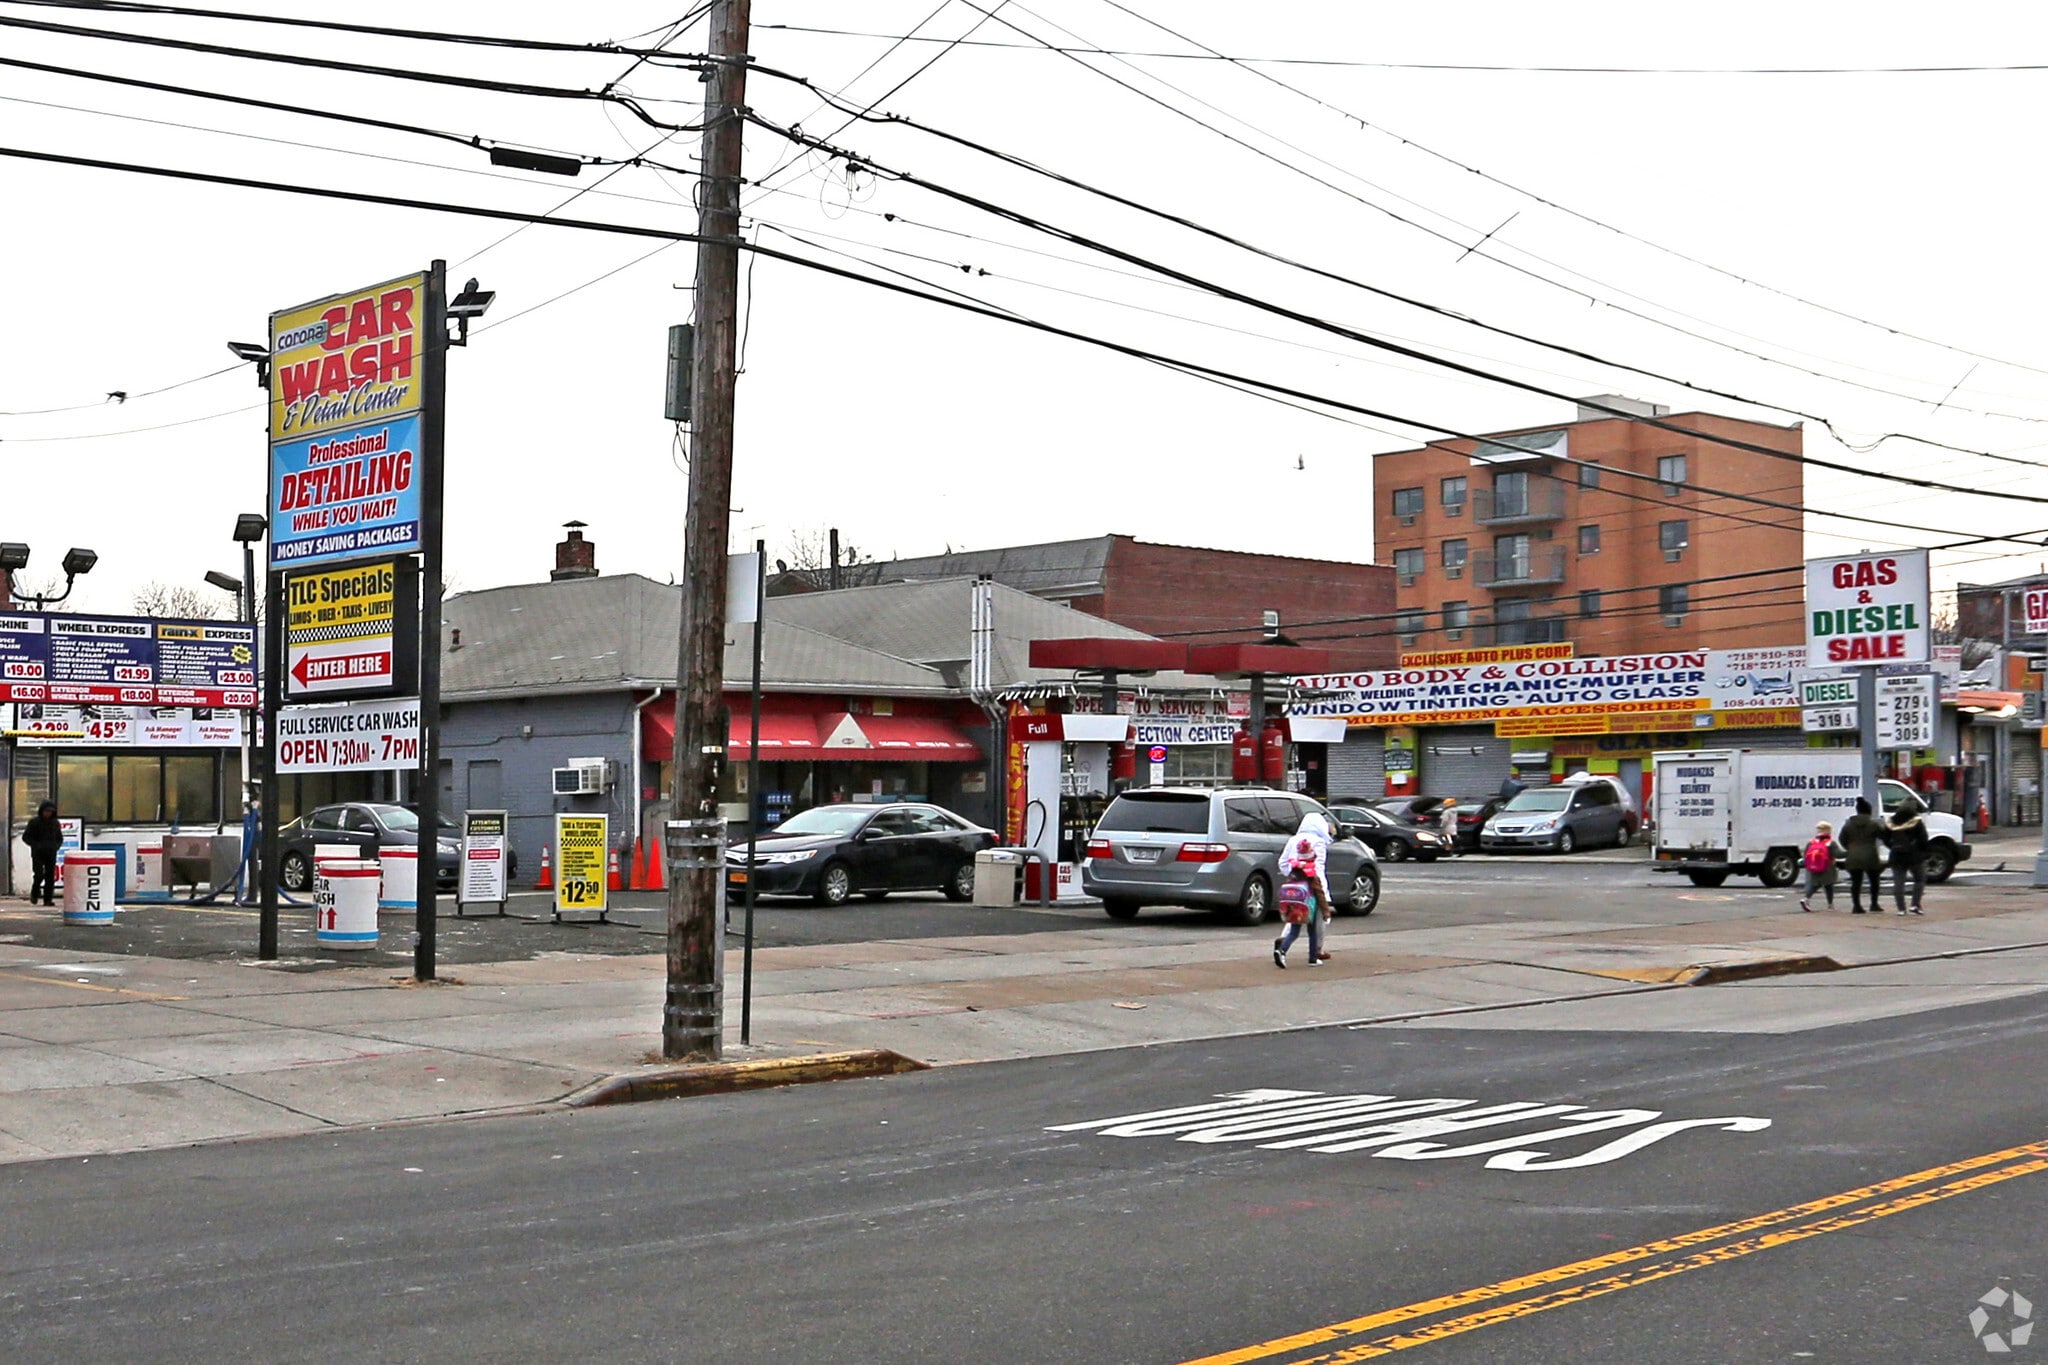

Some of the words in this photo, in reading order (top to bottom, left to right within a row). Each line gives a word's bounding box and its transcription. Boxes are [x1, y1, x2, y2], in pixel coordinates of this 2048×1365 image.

[320, 287, 414, 350] CAR
[280, 334, 412, 406] WASH
[301, 385, 351, 427] Detail
[353, 380, 408, 416] Center
[308, 429, 387, 464] Professional
[280, 452, 412, 511] DETAILING
[293, 510, 329, 531] WHILE
[332, 504, 358, 525] YOU
[361, 498, 397, 520] WAIT!
[277, 541, 315, 559] MONEY
[316, 534, 355, 553] SAVING
[357, 525, 412, 547] PACKAGES
[1832, 558, 1898, 589] GAS
[290, 579, 317, 606] TLC
[320, 569, 393, 604] Specials
[1857, 589, 1873, 604] &
[290, 611, 312, 625] LIMOS
[318, 608, 337, 623] UBER
[368, 600, 392, 615] LIVERY
[1812, 603, 1919, 637] DIESEL
[57, 623, 95, 633] WHEEL
[97, 624, 146, 635] EXPRESS
[205, 630, 251, 640] EXPRESS
[1402, 654, 1465, 668] EXCLUSIVE
[1466, 651, 1497, 663] AUTO
[1501, 648, 1533, 661] PLUS
[1536, 645, 1571, 659] CORP.
[1827, 634, 1906, 662] SALE
[7, 664, 42, 676] $19.00
[117, 668, 150, 679] $21.99
[307, 660, 346, 679] ENTER
[349, 655, 382, 674] HERE
[1291, 675, 1374, 690] AUTO
[1382, 667, 1471, 686] BODY
[1481, 666, 1506, 680] &
[1515, 653, 1708, 678] COLLISION
[220, 672, 252, 683] $23.00
[1361, 688, 1415, 700] WELDING
[1429, 676, 1568, 697] MECHANIC
[1582, 671, 1705, 688] MUFFLER
[13, 686, 44, 698] $16.00
[123, 690, 151, 700] $18.00
[225, 694, 252, 703] $20.00
[1291, 700, 1400, 716] WINDOW
[1408, 693, 1511, 711] TINTING
[1525, 690, 1606, 704] AUTO
[1610, 685, 1701, 701] GLASS
[1805, 682, 1855, 703] DIESEL
[1159, 700, 1206, 715] SERVICE
[1724, 699, 1765, 708] 108-04
[1770, 698, 1783, 706] 47
[1895, 696, 1919, 710] 279
[1345, 712, 1419, 725] MUSIC
[1422, 708, 1501, 722] SYSTEM
[1506, 707, 1522, 718] &
[1529, 700, 1697, 717] ACCESSORIES
[1725, 711, 1776, 725] WINDOW
[1818, 712, 1841, 728] 319
[1895, 711, 1919, 725] 295
[280, 718, 306, 735] FULL
[309, 715, 354, 734] SERVICE
[357, 713, 380, 731] CAR
[383, 710, 418, 728] WASH
[1028, 723, 1048, 734] Full
[1188, 726, 1235, 742] CENTER
[1895, 727, 1919, 741] 309
[280, 739, 328, 764] OPEN
[332, 739, 369, 766] 7:30AM
[381, 734, 417, 760] 7PM
[1677, 767, 1715, 778] MUDANZAS
[1681, 784, 1711, 794] DELIVERY
[1755, 776, 1807, 790] MUDANZAS
[1809, 777, 1815, 788] &
[1817, 775, 1861, 790] DELIVERY
[1059, 865, 1071, 874] GAS
[87, 866, 100, 911] OPEN
